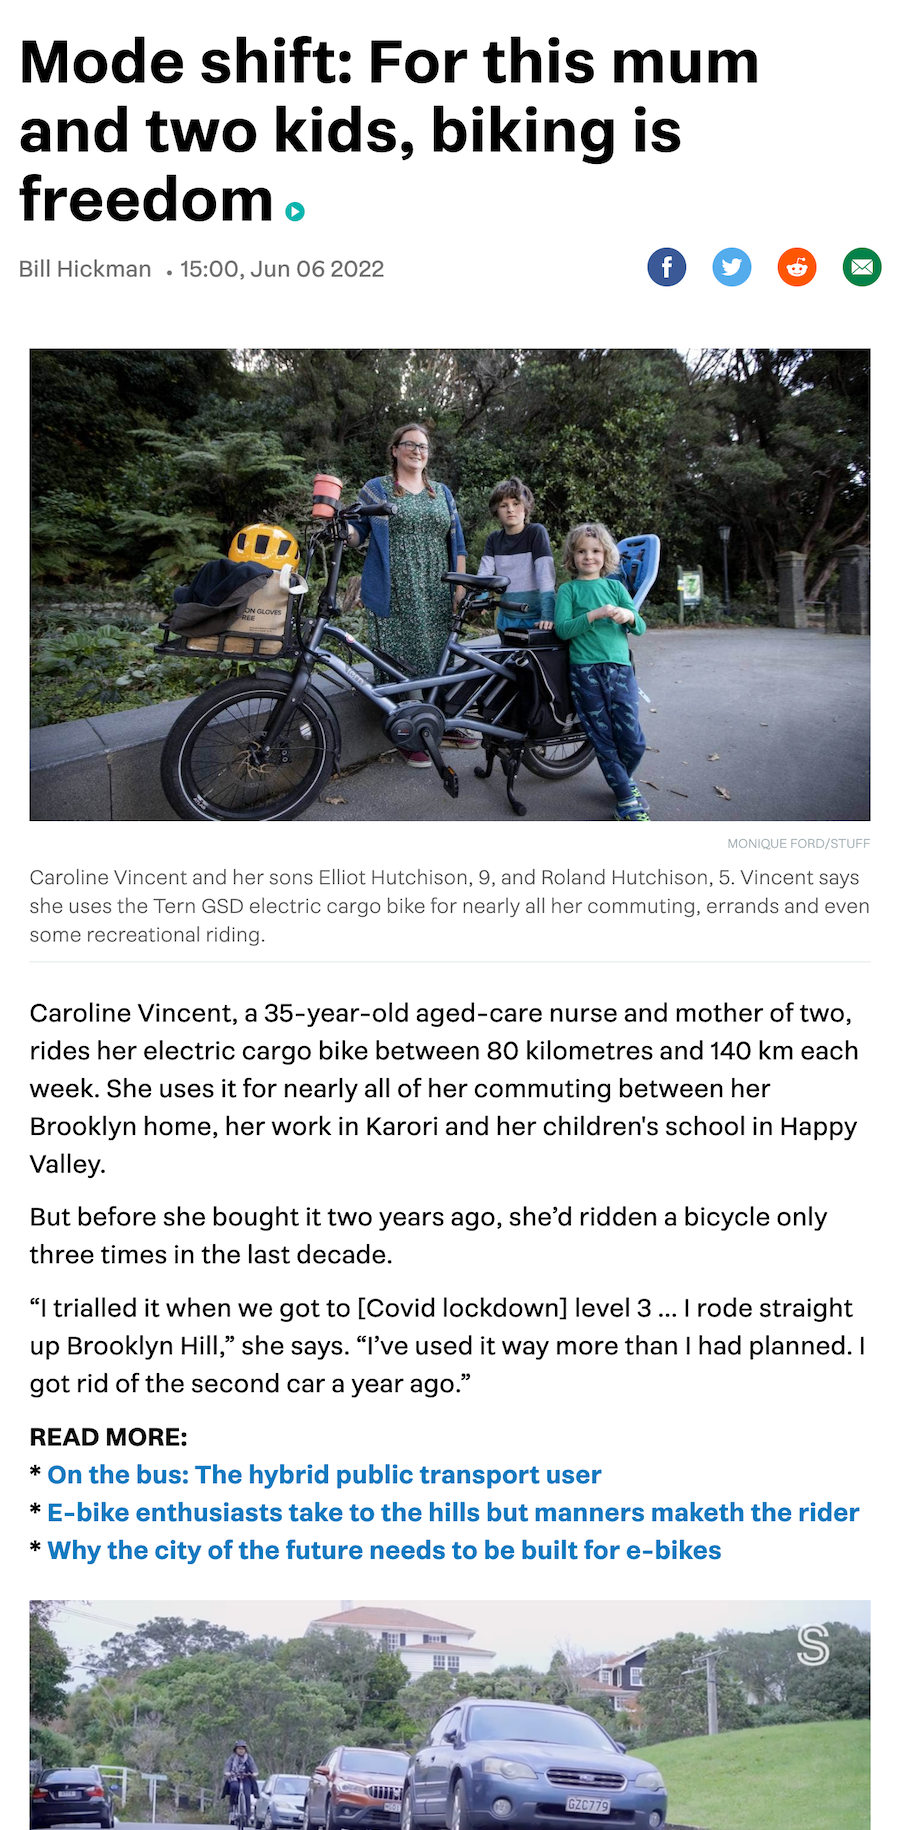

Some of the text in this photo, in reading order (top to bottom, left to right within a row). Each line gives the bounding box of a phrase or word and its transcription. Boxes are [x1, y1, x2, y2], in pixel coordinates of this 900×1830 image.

[22, 36, 757, 84] Mode shift: For this mum
[20, 105, 681, 164] and two kids, biking is
[19, 174, 271, 222] freedom
[20, 259, 384, 280] Bill Hickman 15:00, Jun 06 2022
[256, 608, 282, 616] GLOVES
[728, 838, 870, 850] MONIQUE FORD/STUFF
[30, 869, 859, 889] Caroline Vincent and her sons Elliot Hutchison, 9, and Roland Hutchison, 5. Vincent says
[30, 926, 264, 946] some recreational riding.
[30, 1002, 851, 1027] Caroline Vincent, a 35-year-old aged-care nurse and mother of two,
[29, 1153, 105, 1178] Valley.
[31, 1427, 187, 1446] READ MORE:
[48, 1464, 602, 1489] On the bus: The hybrid public transport user
[568, 1798, 609, 1812] GZC779
